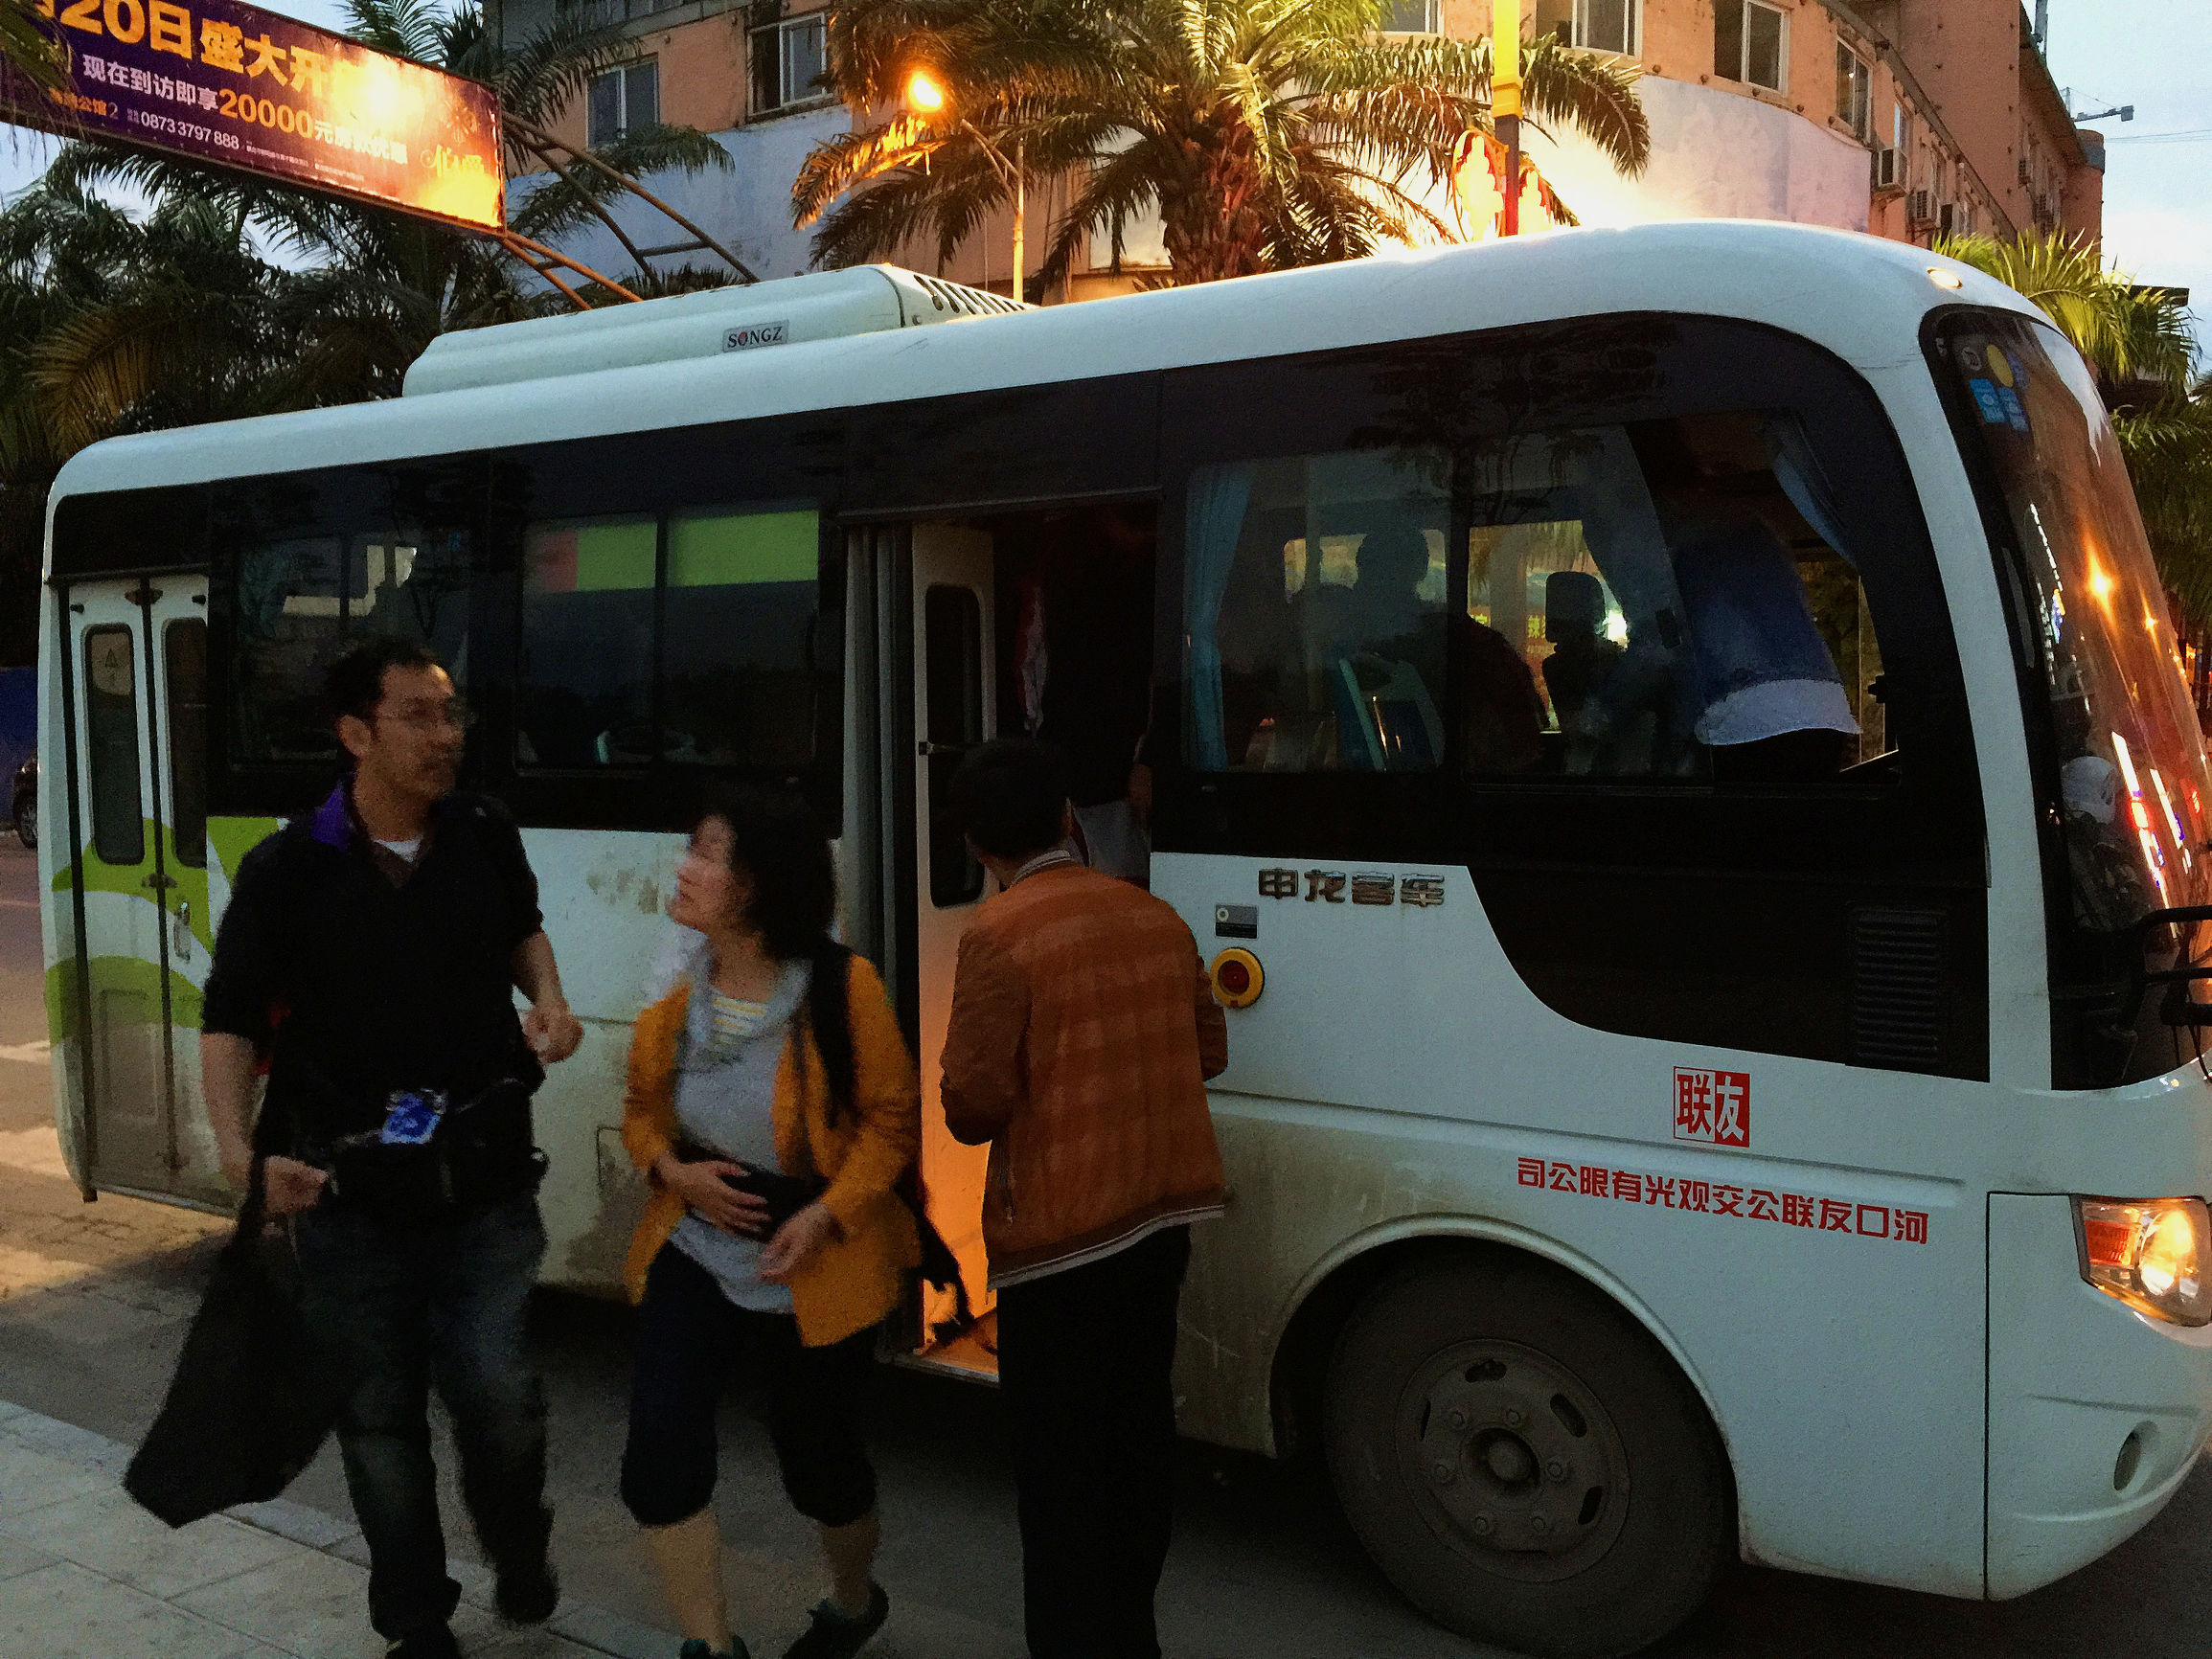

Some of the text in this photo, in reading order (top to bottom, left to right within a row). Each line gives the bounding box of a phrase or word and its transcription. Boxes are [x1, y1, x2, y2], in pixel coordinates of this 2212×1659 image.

[141, 111, 176, 134] 0873
[178, 120, 212, 142] 3797
[214, 130, 239, 150] 888
[727, 326, 783, 349] SONGZ
[1258, 868, 1445, 907] 申龙客车
